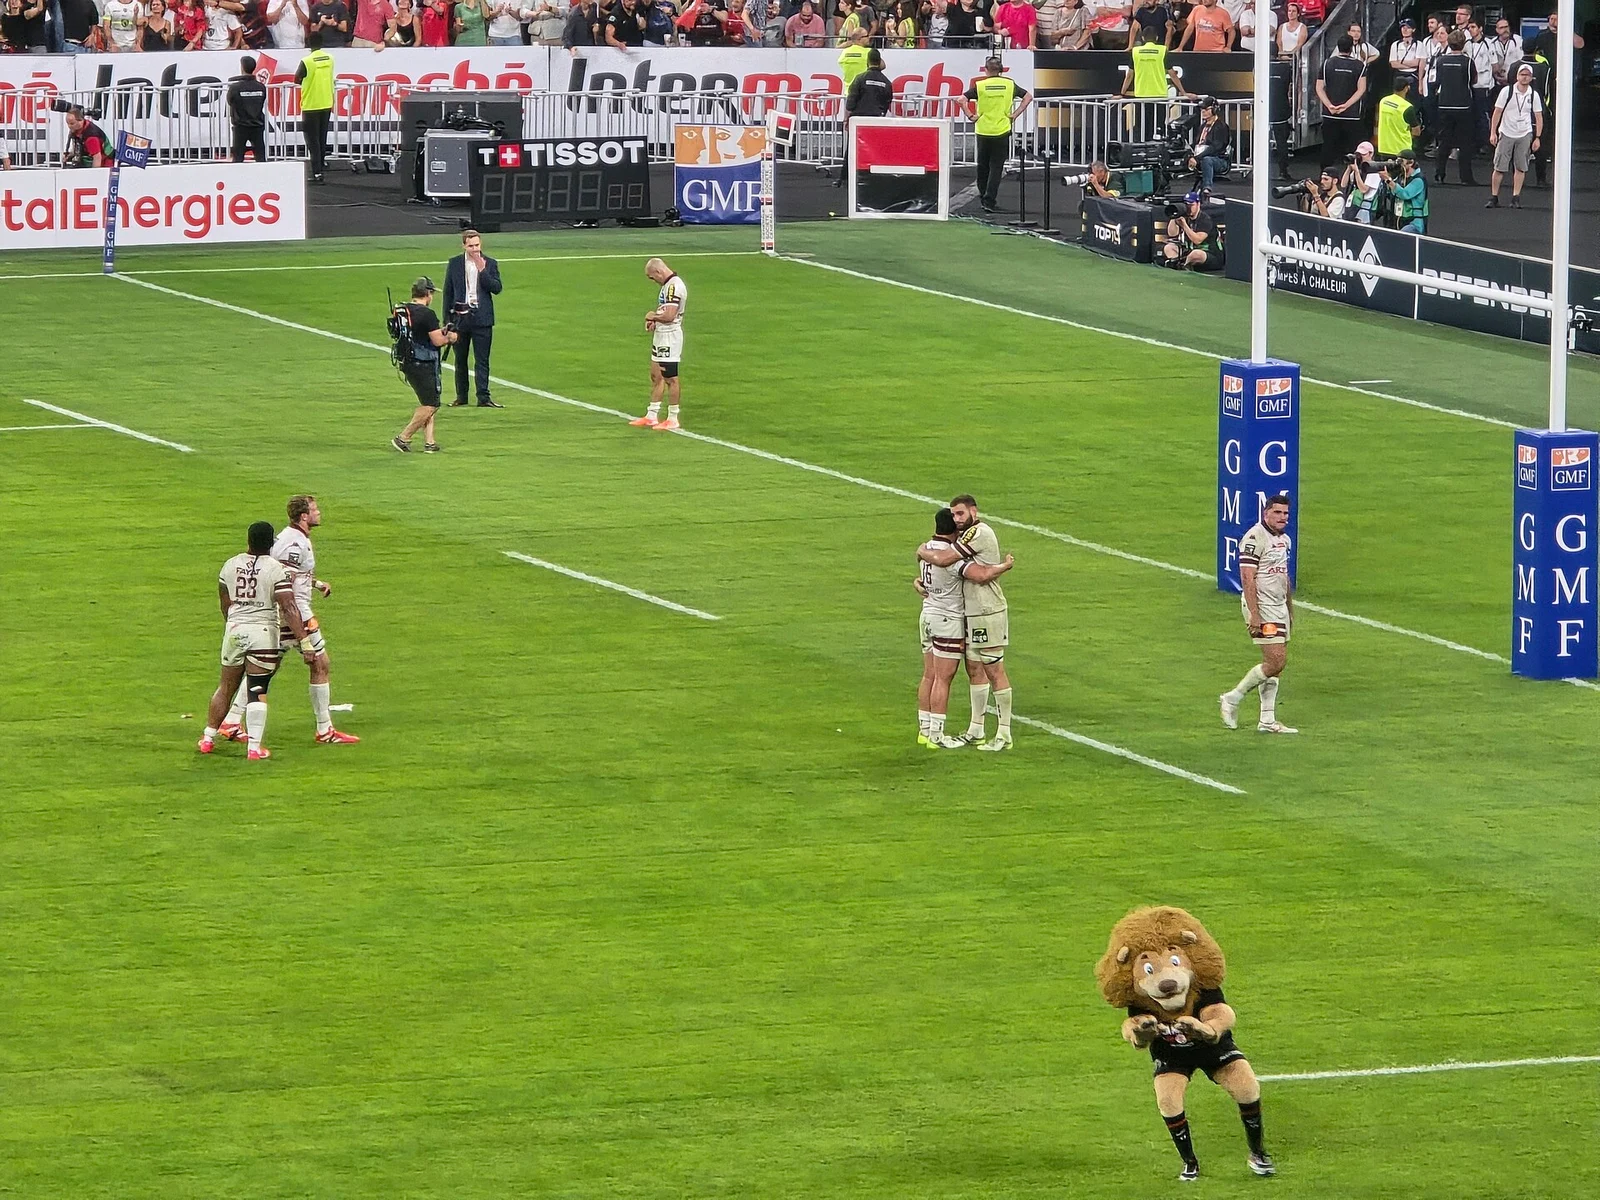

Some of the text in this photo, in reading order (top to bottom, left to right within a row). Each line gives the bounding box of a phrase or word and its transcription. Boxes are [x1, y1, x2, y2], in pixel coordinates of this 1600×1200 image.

[125, 149, 144, 162] GMF
[523, 140, 645, 167] TISSOT
[682, 179, 762, 212] GMF
[1309, 275, 1347, 294] CHALEUR
[1225, 396, 1241, 411] GMF
[1259, 398, 1289, 413] GMF
[1520, 467, 1536, 483] GMF
[1554, 469, 1588, 484] GMF
[235, 577, 258, 599] 23
[1517, 512, 1536, 654] GMF
[1551, 514, 1590, 658] GMF
